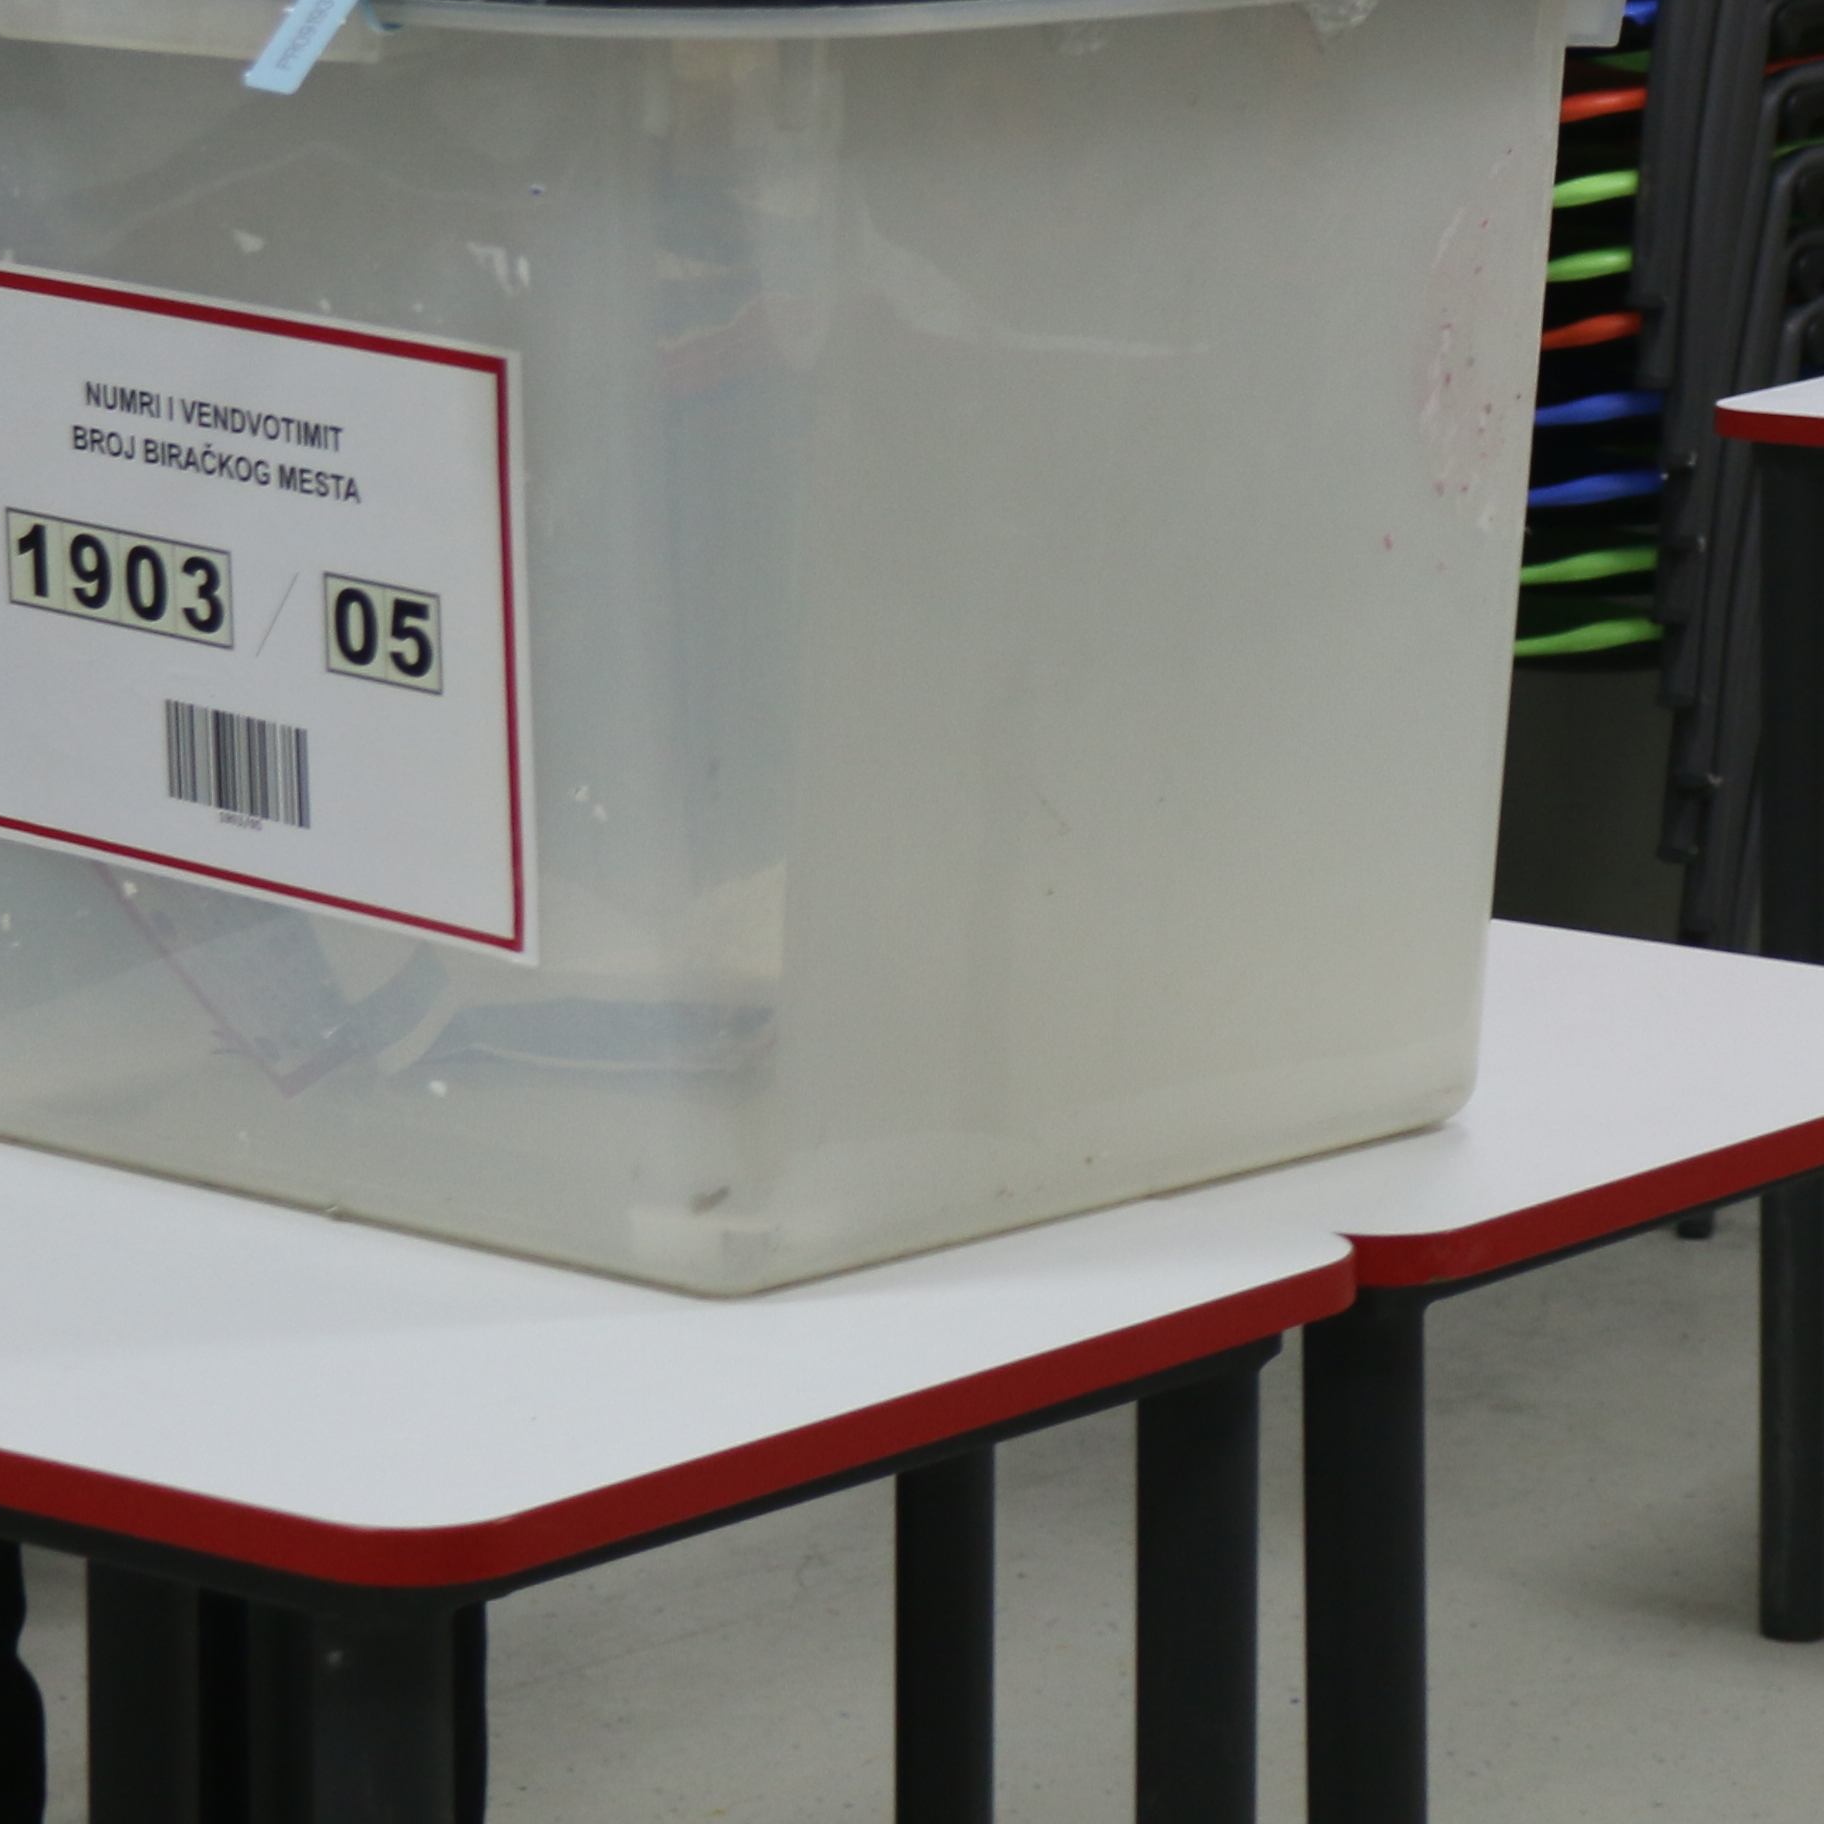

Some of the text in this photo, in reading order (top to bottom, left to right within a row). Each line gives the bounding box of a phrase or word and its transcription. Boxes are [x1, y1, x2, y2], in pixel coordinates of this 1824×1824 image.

[84, 381, 343, 452] NUMRI I VENDVOTIMIT
[72, 425, 362, 504] BROJ BIRAČKOG MESTA
[17, 523, 225, 634] 1903
[334, 587, 433, 678] 05
